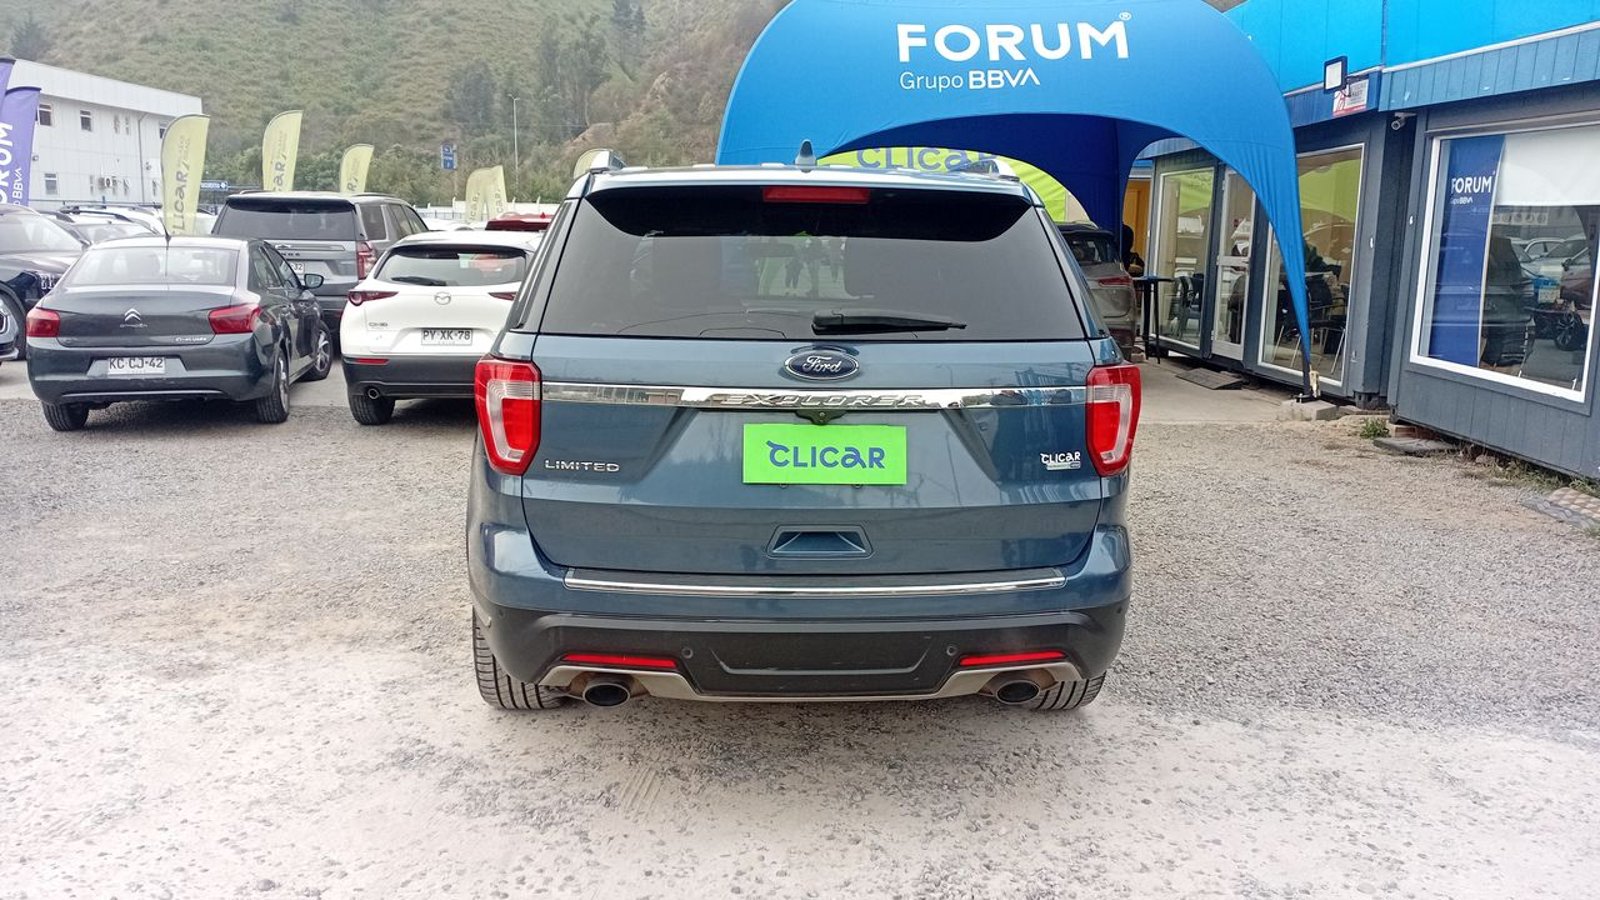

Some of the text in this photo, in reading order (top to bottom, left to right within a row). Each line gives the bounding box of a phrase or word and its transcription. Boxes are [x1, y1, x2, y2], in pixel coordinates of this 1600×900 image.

[900, 67, 1041, 92] Grupo BBVA
[12, 167, 24, 199] BBVA
[1450, 176, 1492, 194] FORUM
[801, 355, 843, 374] Ford
[718, 393, 925, 408] EXPLORER
[544, 459, 620, 472] LIMITED
